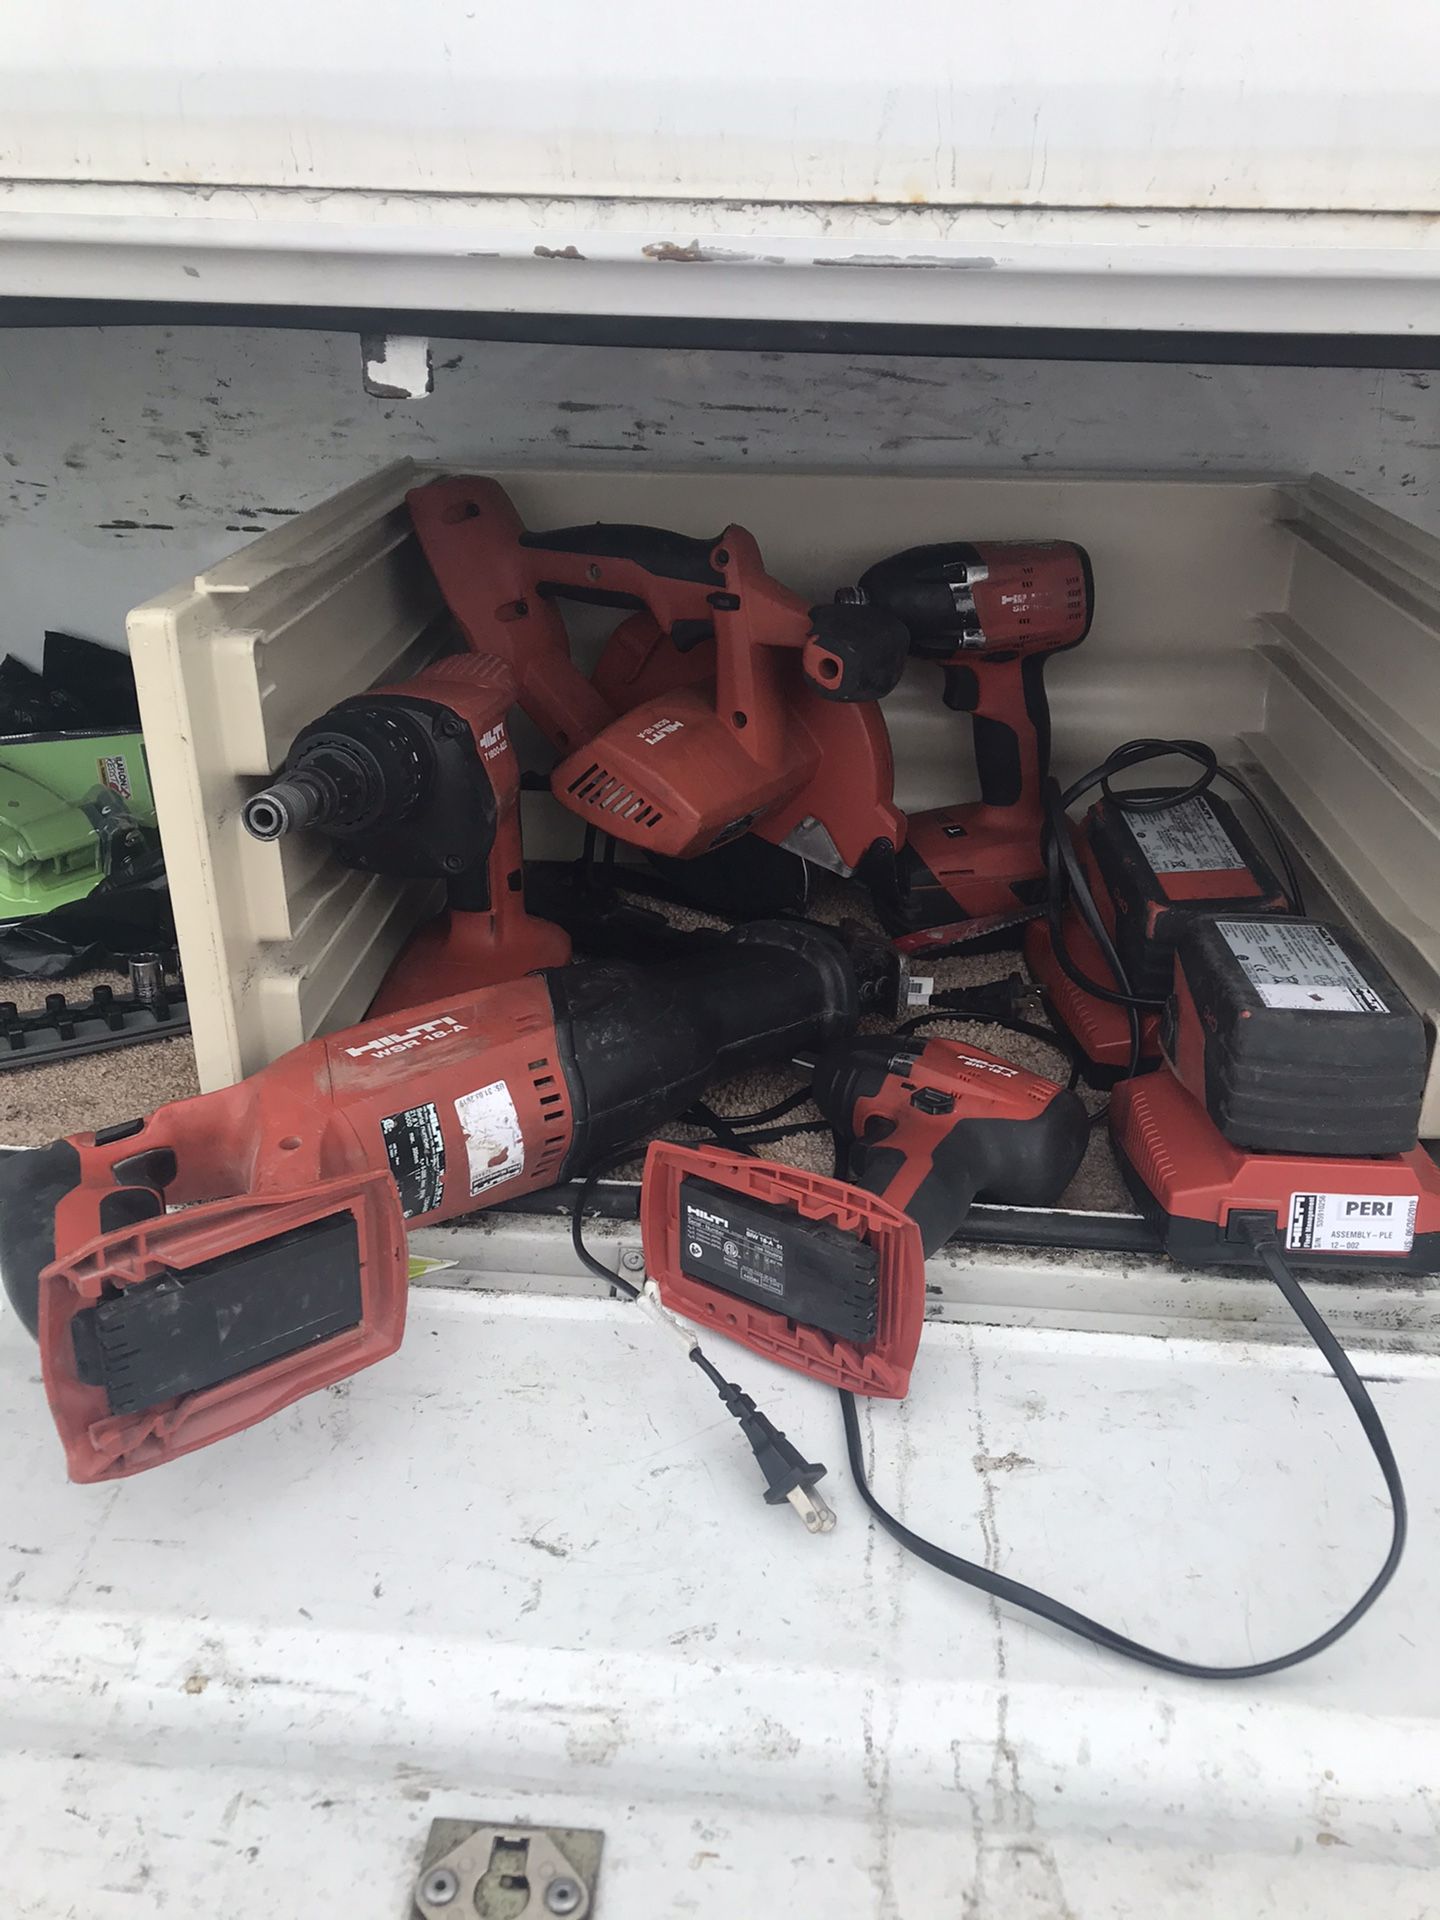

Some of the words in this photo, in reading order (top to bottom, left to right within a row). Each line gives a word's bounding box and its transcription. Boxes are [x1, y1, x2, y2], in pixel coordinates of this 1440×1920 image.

[644, 720, 684, 745] HILTI
[346, 1015, 459, 1057] HILTI
[370, 1038, 421, 1060] WSR
[423, 1023, 470, 1042] 18-A
[957, 1055, 1019, 1075] HILTI
[426, 1102, 444, 1152] HILTI
[687, 1205, 729, 1229] HILTI
[1291, 1196, 1305, 1248] HILTI
[1305, 1196, 1316, 1233] Management
[1345, 1201, 1393, 1216] PERI
[1303, 1233, 1311, 1248] Fleet
